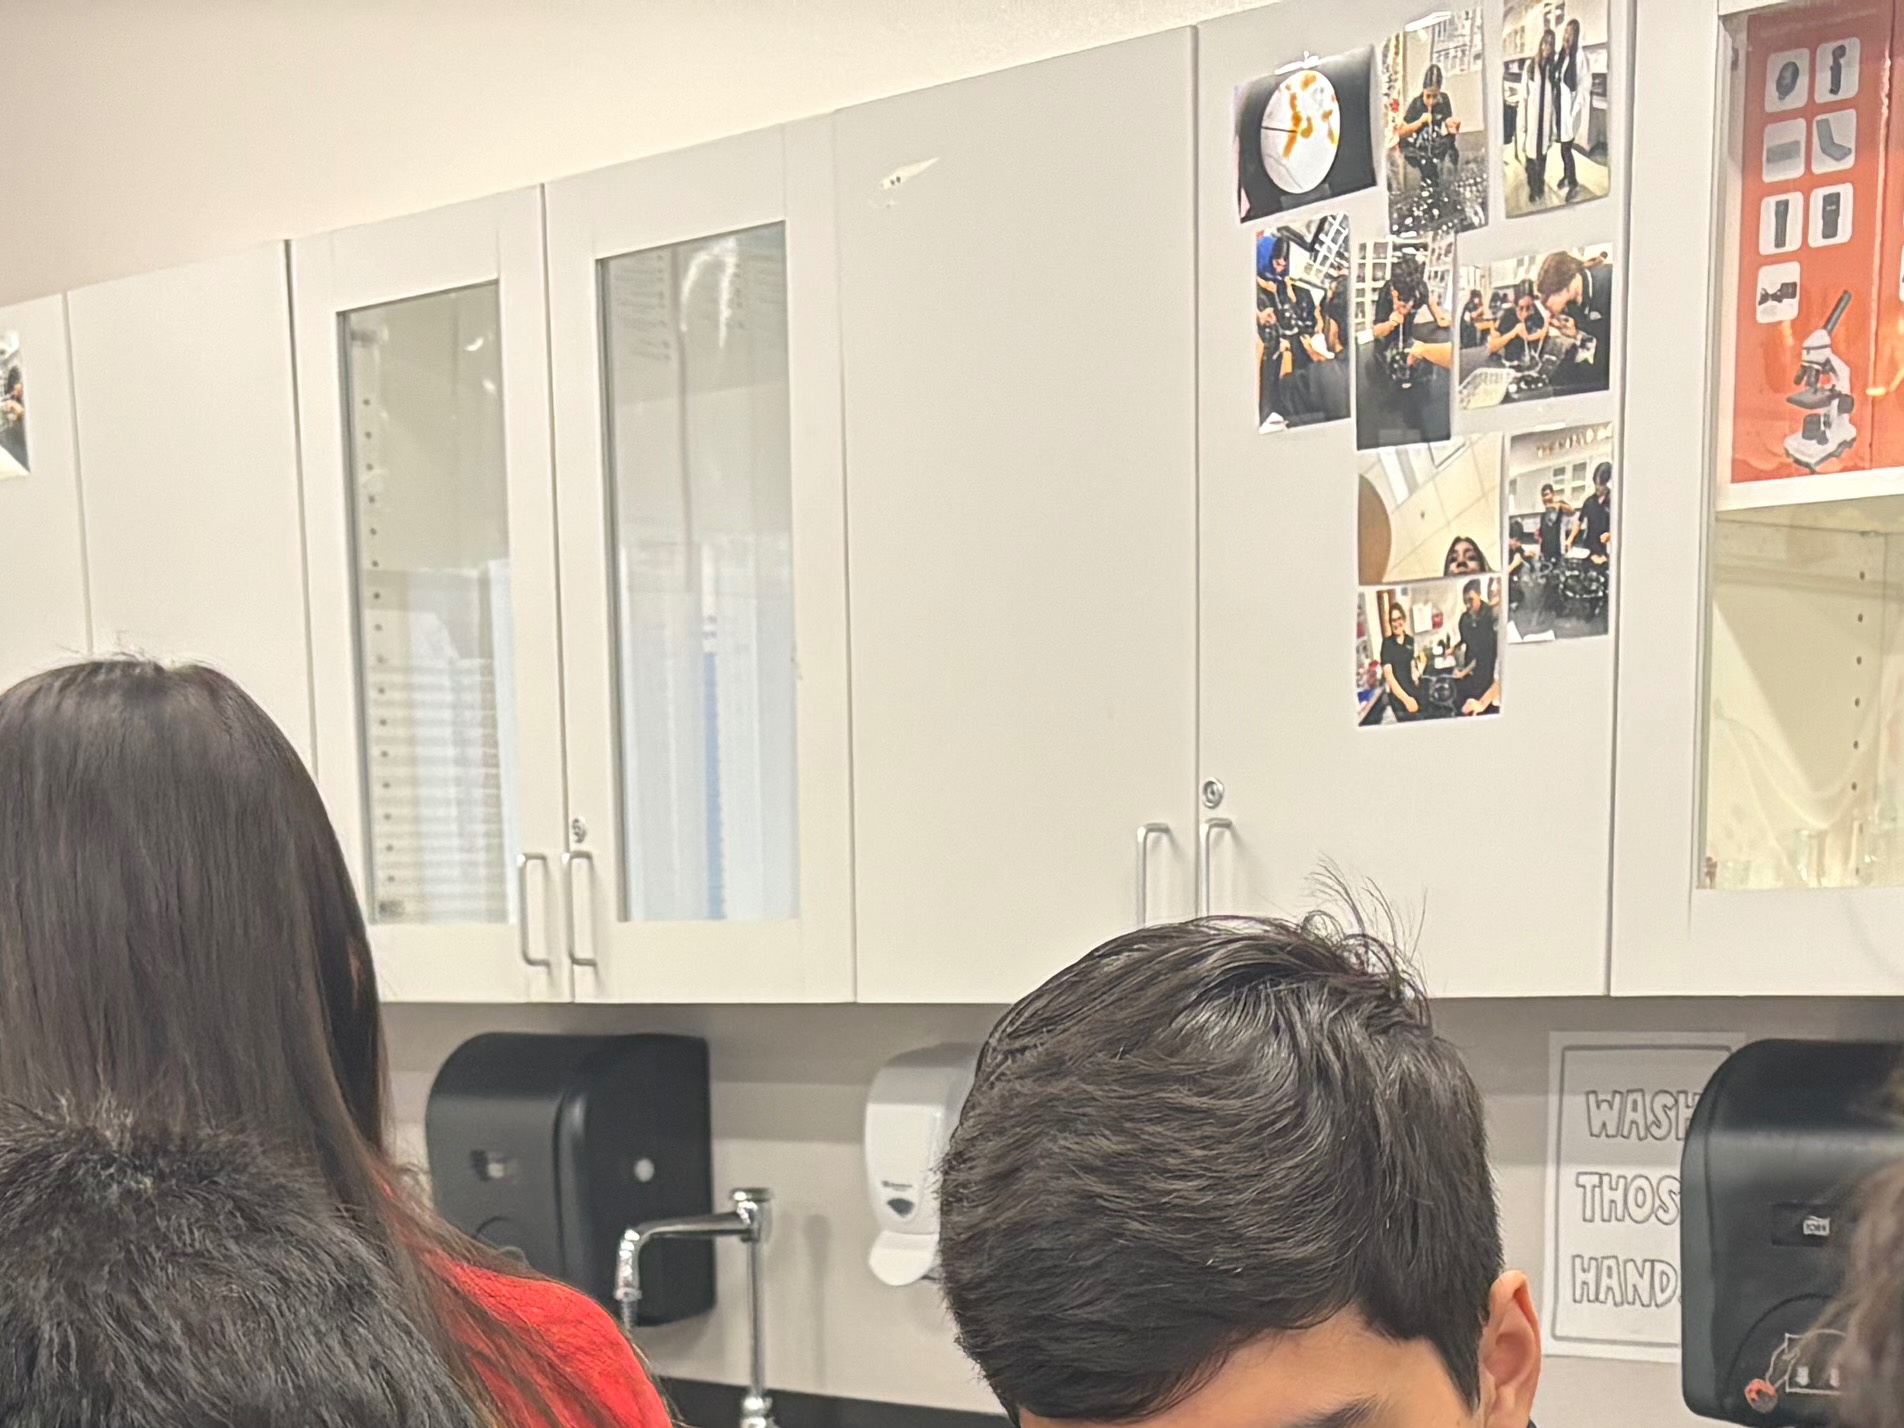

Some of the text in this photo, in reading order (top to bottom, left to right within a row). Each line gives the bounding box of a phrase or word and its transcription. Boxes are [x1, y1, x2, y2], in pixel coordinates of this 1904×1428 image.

[1585, 1088, 1702, 1142] WASH
[1576, 1171, 1681, 1226] THOS
[1571, 1254, 1681, 1308] HAND
